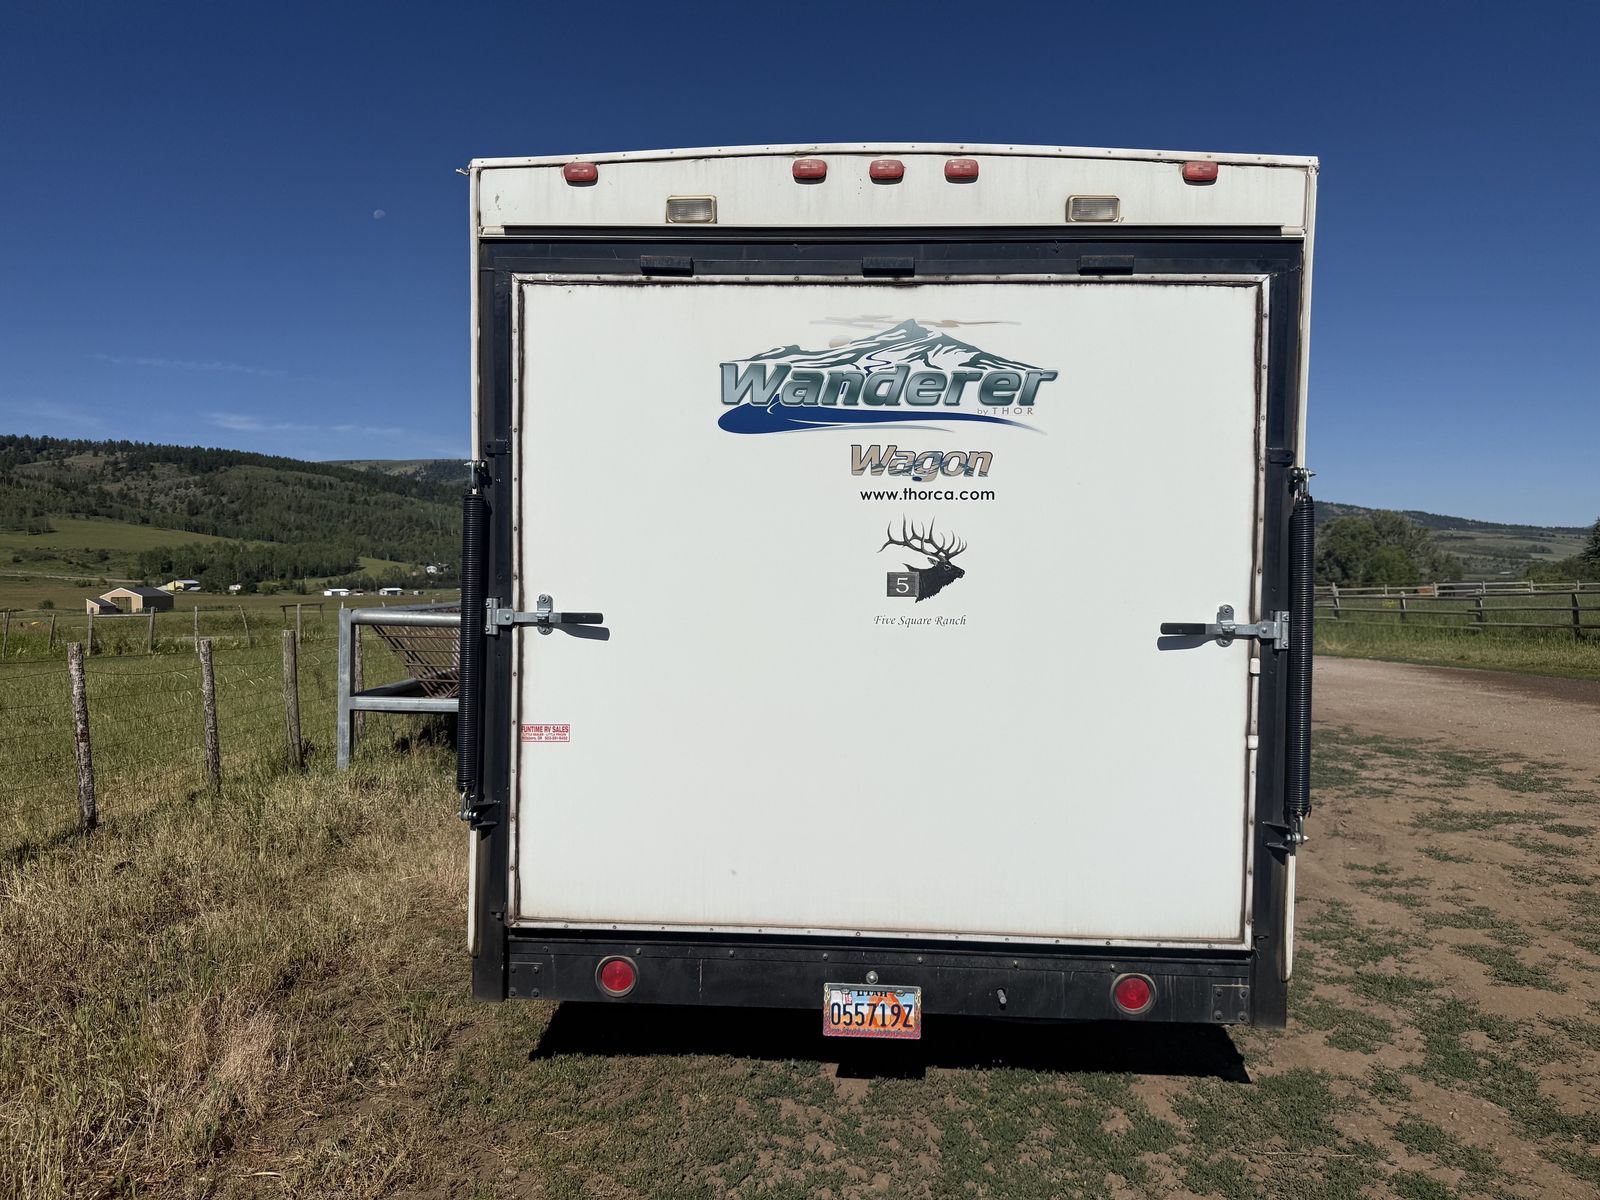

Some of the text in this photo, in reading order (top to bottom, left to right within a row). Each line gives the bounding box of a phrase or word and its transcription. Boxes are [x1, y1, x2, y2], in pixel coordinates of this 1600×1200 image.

[719, 362, 1059, 407] Wanderer
[977, 407, 1034, 416] by THOR
[850, 444, 994, 482] Wagon
[860, 487, 996, 501] www.thorca.com
[895, 577, 910, 594] 5
[873, 614, 967, 628] Five Square Ranch
[552, 725, 569, 733] SALES
[831, 1002, 914, 1028] 055719Z
